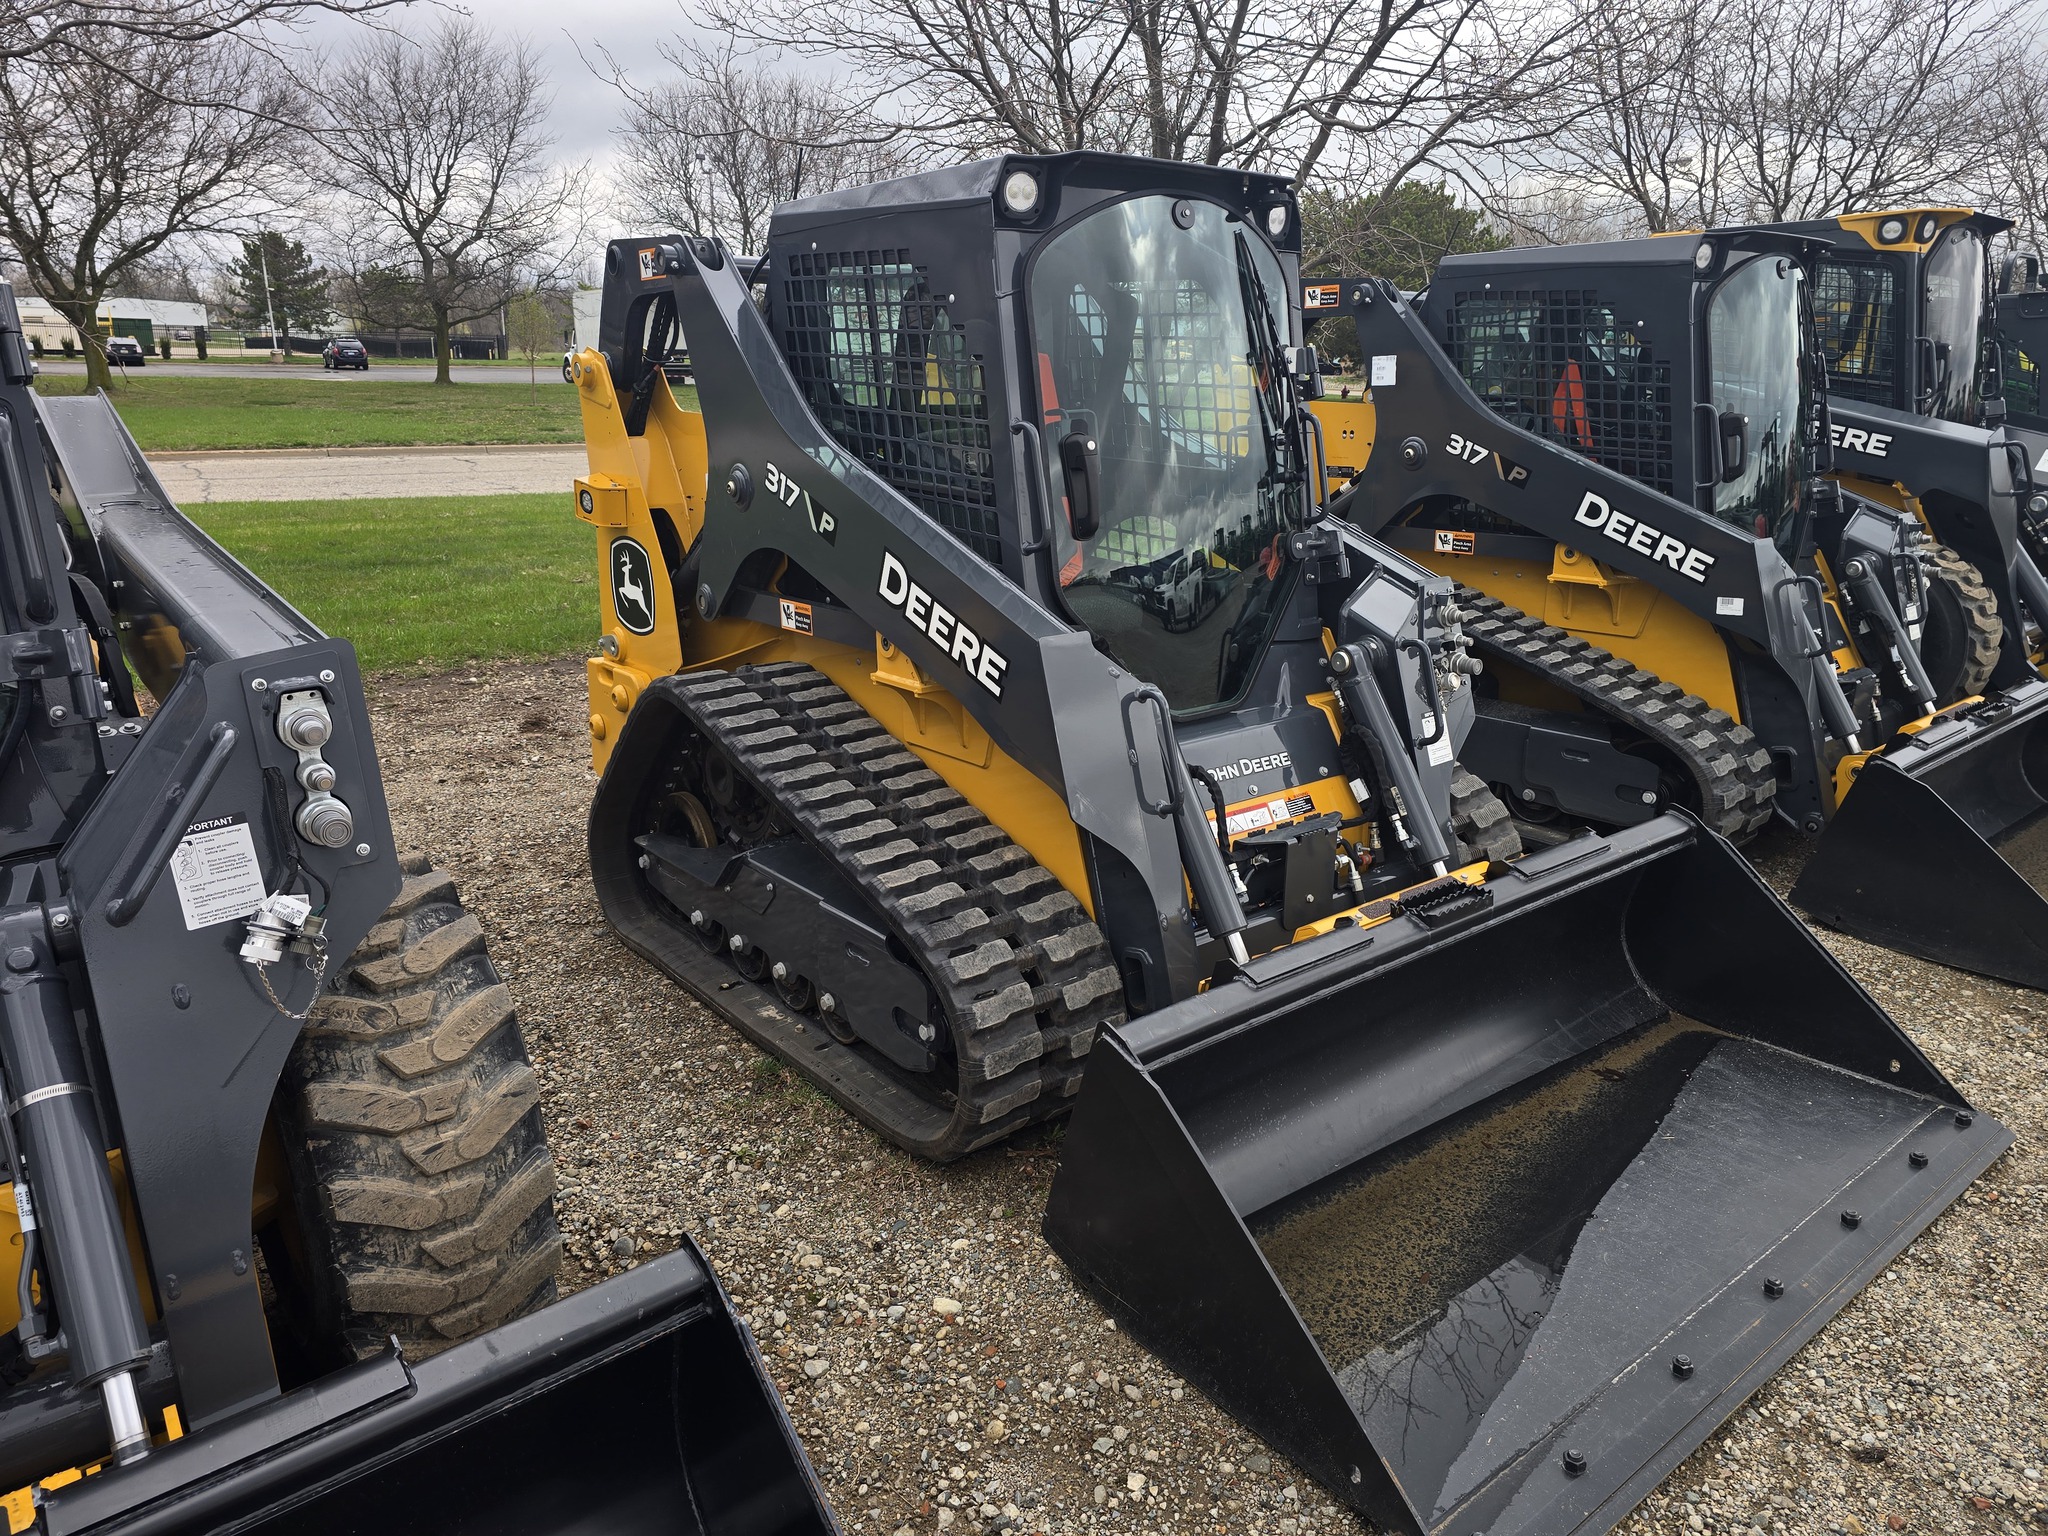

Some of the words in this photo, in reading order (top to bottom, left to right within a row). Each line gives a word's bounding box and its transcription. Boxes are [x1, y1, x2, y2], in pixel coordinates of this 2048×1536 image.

[1445, 433, 1489, 465] 317
[765, 462, 800, 508] 317
[1574, 490, 1715, 583] DEERE
[879, 551, 1008, 698] DEERE
[1199, 764, 1240, 785] OHN
[1239, 752, 1291, 776] DEERE
[184, 816, 233, 833] PORTANT
